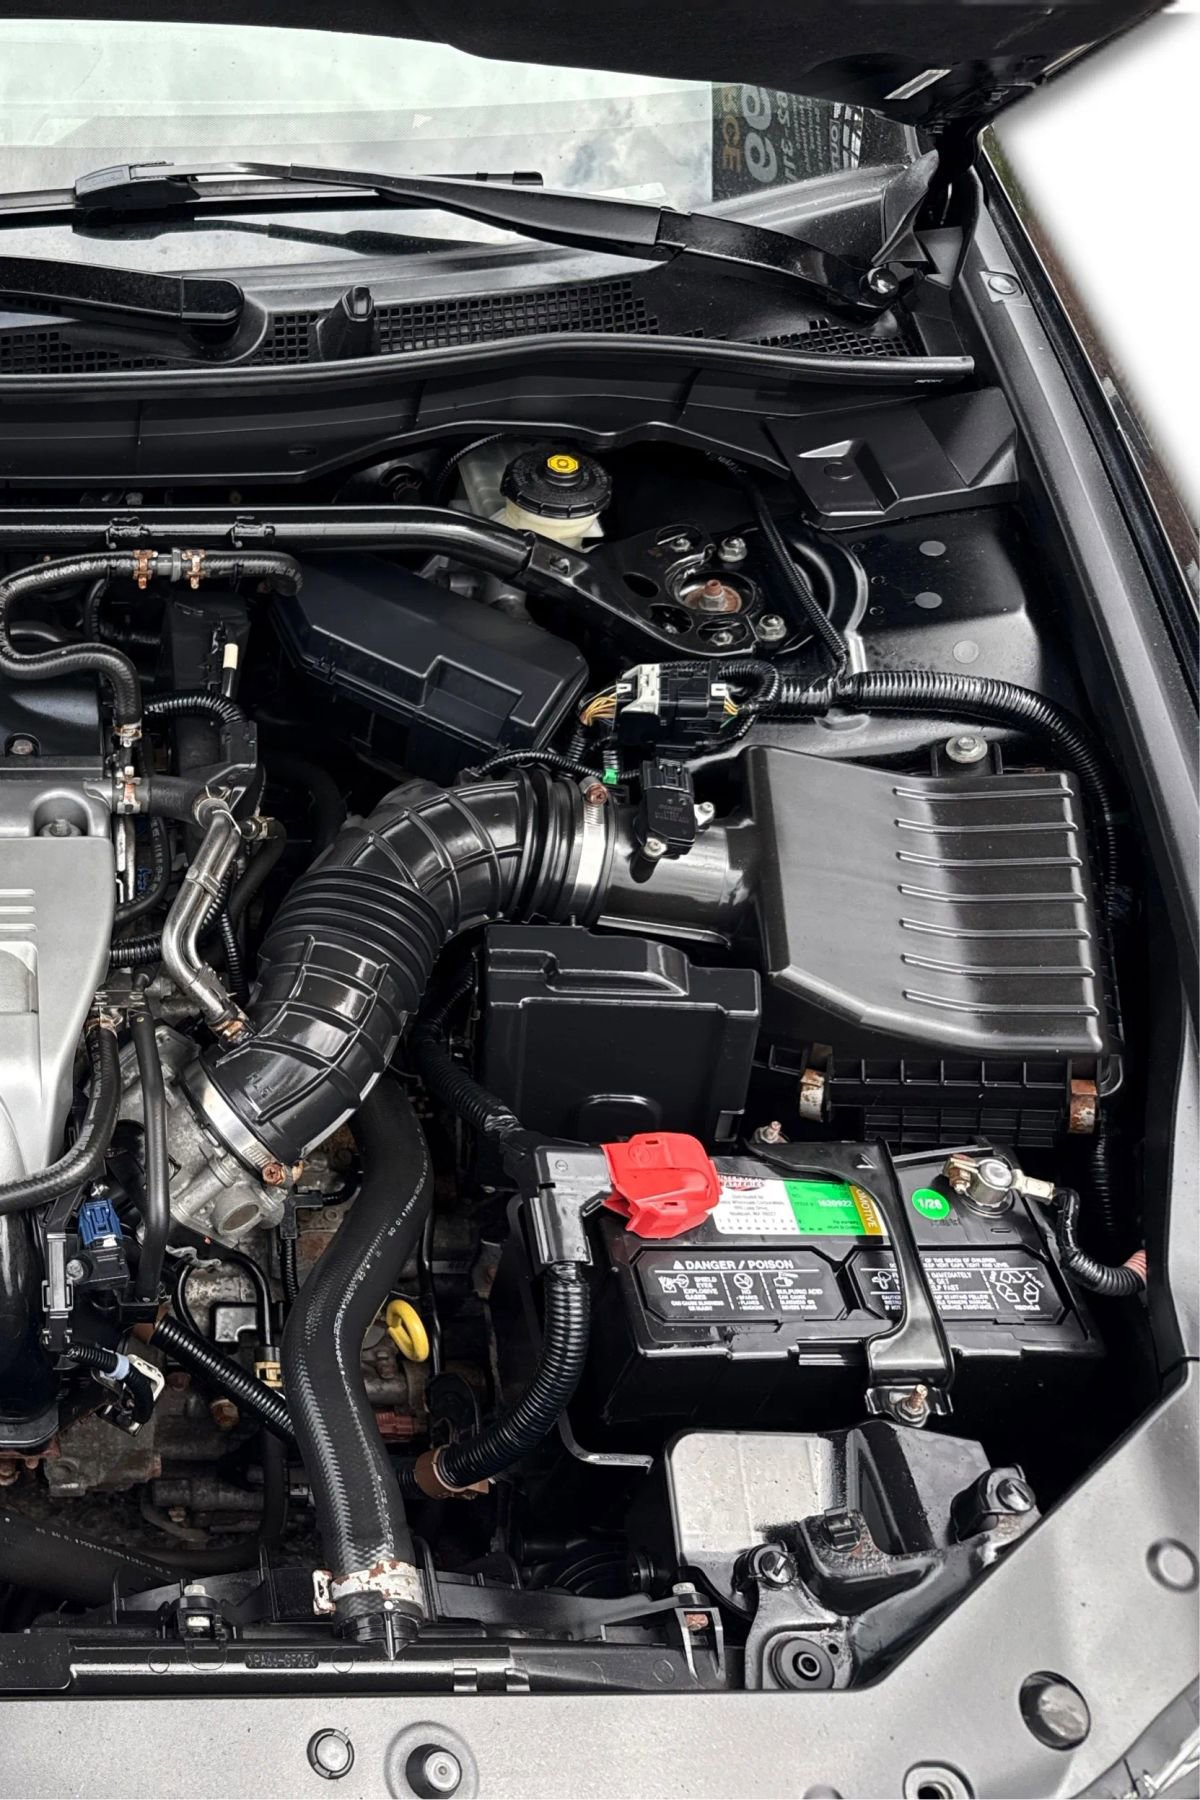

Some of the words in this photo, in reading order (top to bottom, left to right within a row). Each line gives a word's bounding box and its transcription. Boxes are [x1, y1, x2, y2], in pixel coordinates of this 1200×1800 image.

[856, 1189, 878, 1229] OMOTIVE
[685, 1260, 736, 1269] DANGER
[738, 1260, 745, 1269] /
[749, 1260, 793, 1269] POISON
